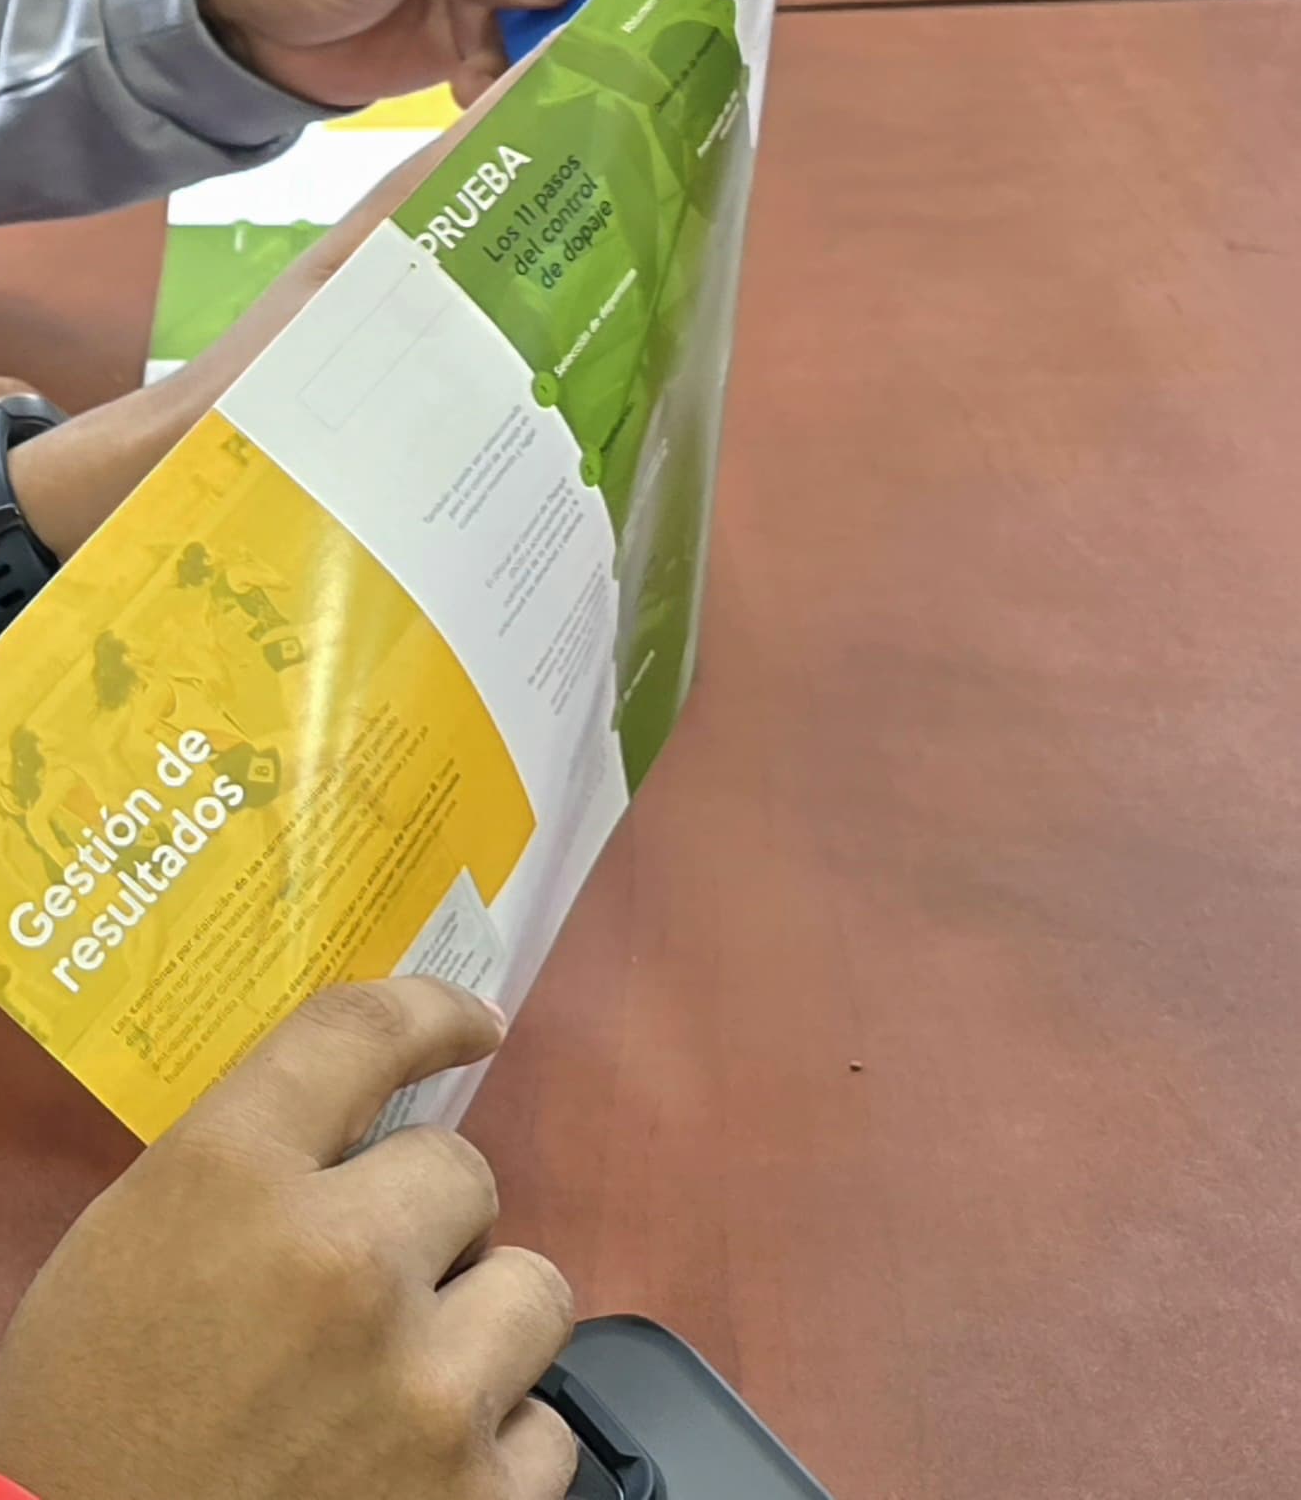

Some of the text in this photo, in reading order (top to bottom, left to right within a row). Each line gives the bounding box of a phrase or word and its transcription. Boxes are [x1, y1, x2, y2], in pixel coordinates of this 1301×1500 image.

[414, 145, 532, 256] PRUEBA
[482, 153, 582, 263] Los 11 pasos
[514, 173, 599, 277] del control
[540, 200, 614, 290] de dopaje
[9, 729, 211, 948] Gestión de
[51, 774, 245, 994] resultados
